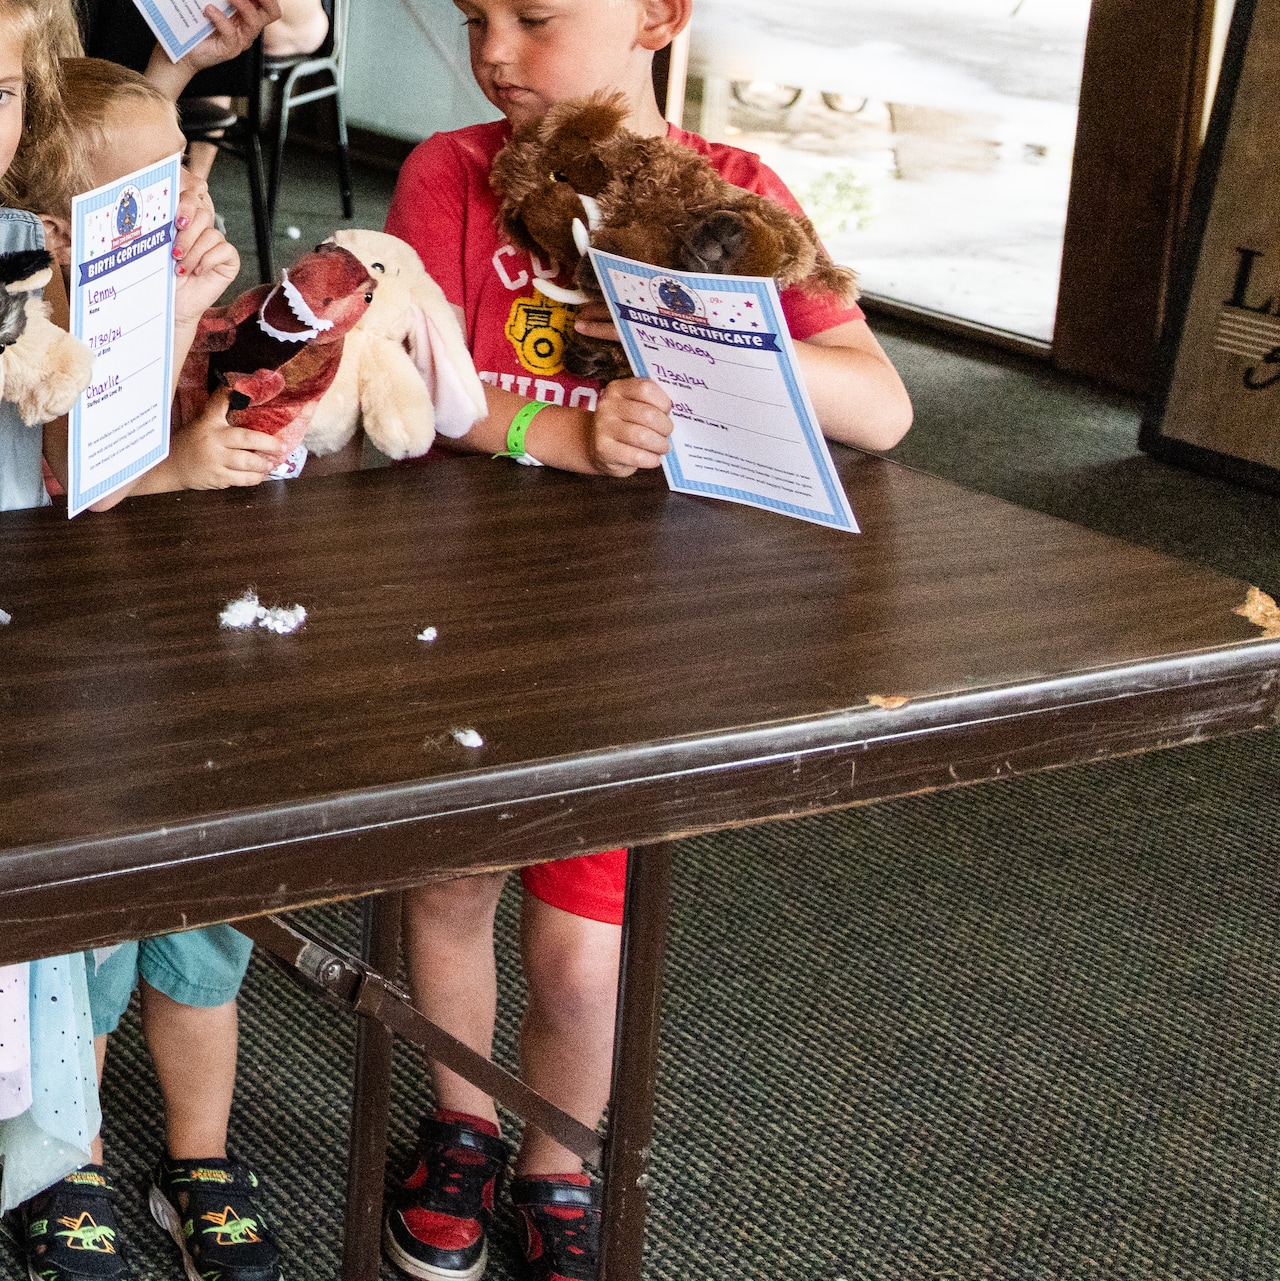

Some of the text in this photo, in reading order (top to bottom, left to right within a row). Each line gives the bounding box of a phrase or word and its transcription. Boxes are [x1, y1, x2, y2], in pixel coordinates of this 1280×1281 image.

[88, 255, 115, 278] BIRTH
[88, 286, 116, 304] Lenny
[629, 309, 670, 328] BIRTH
[89, 327, 121, 348] 7/30/24
[636, 328, 716, 365] Mr Wooley
[86, 375, 119, 399] Charlie
[651, 363, 709, 390] 7/30/24
